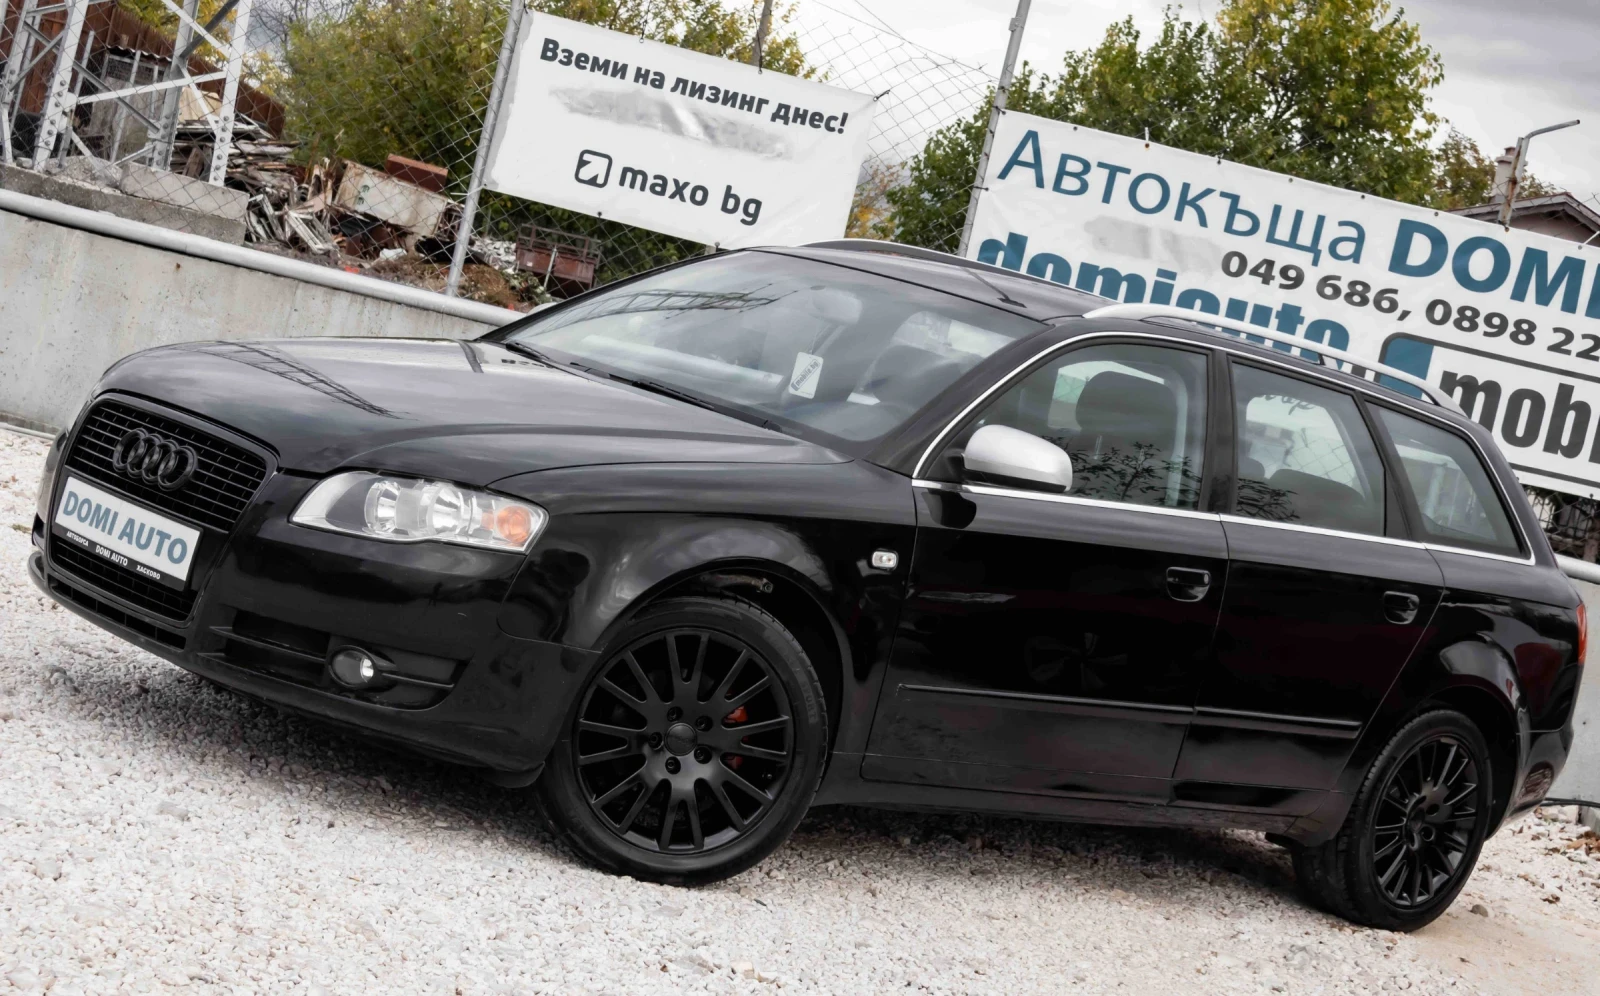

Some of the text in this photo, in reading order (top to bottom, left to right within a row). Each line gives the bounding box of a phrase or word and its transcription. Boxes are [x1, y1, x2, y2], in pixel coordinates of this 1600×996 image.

[539, 37, 849, 135] Вземи на лизинг днес!
[618, 165, 763, 226] maxo bg
[1221, 250, 1305, 290] 049
[1316, 274, 1412, 322] 686,
[1425, 298, 1537, 346] 0898
[1439, 370, 1600, 466] mob
[63, 490, 188, 565] DOMI AUTO
[95, 545, 111, 558] DOMI
[111, 552, 128, 566] AUTO
